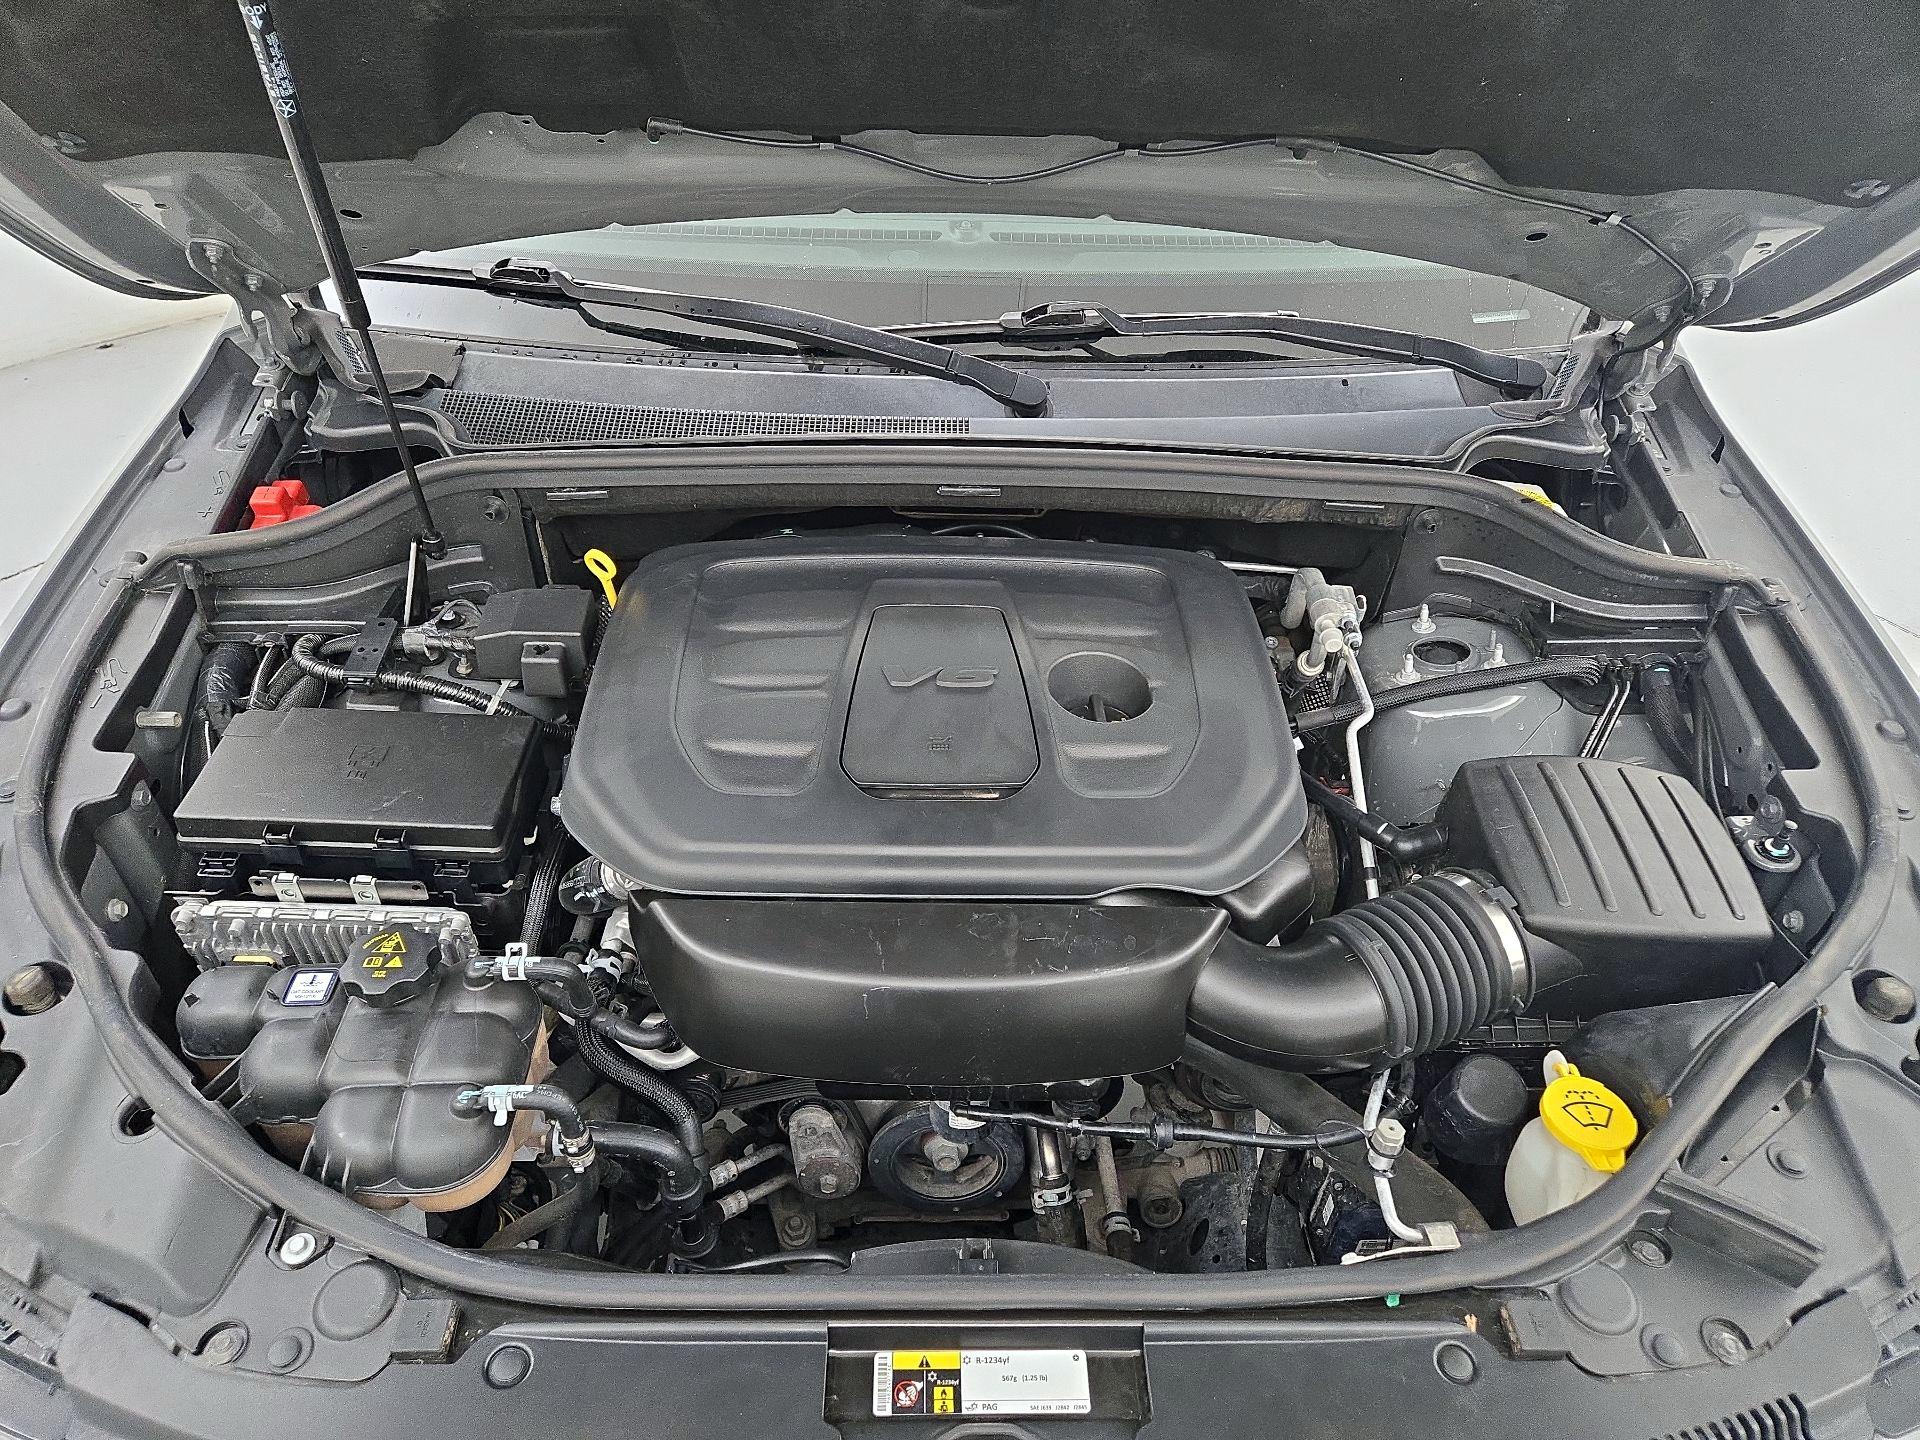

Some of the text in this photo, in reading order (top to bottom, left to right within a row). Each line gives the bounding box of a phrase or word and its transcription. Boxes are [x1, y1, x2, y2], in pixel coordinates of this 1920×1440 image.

[880, 664, 1000, 688] V6
[975, 1356, 1010, 1365] R-1234yf
[1001, 1374, 1048, 1382] 567g (1.25 lb)
[981, 1403, 998, 1411] PAG
